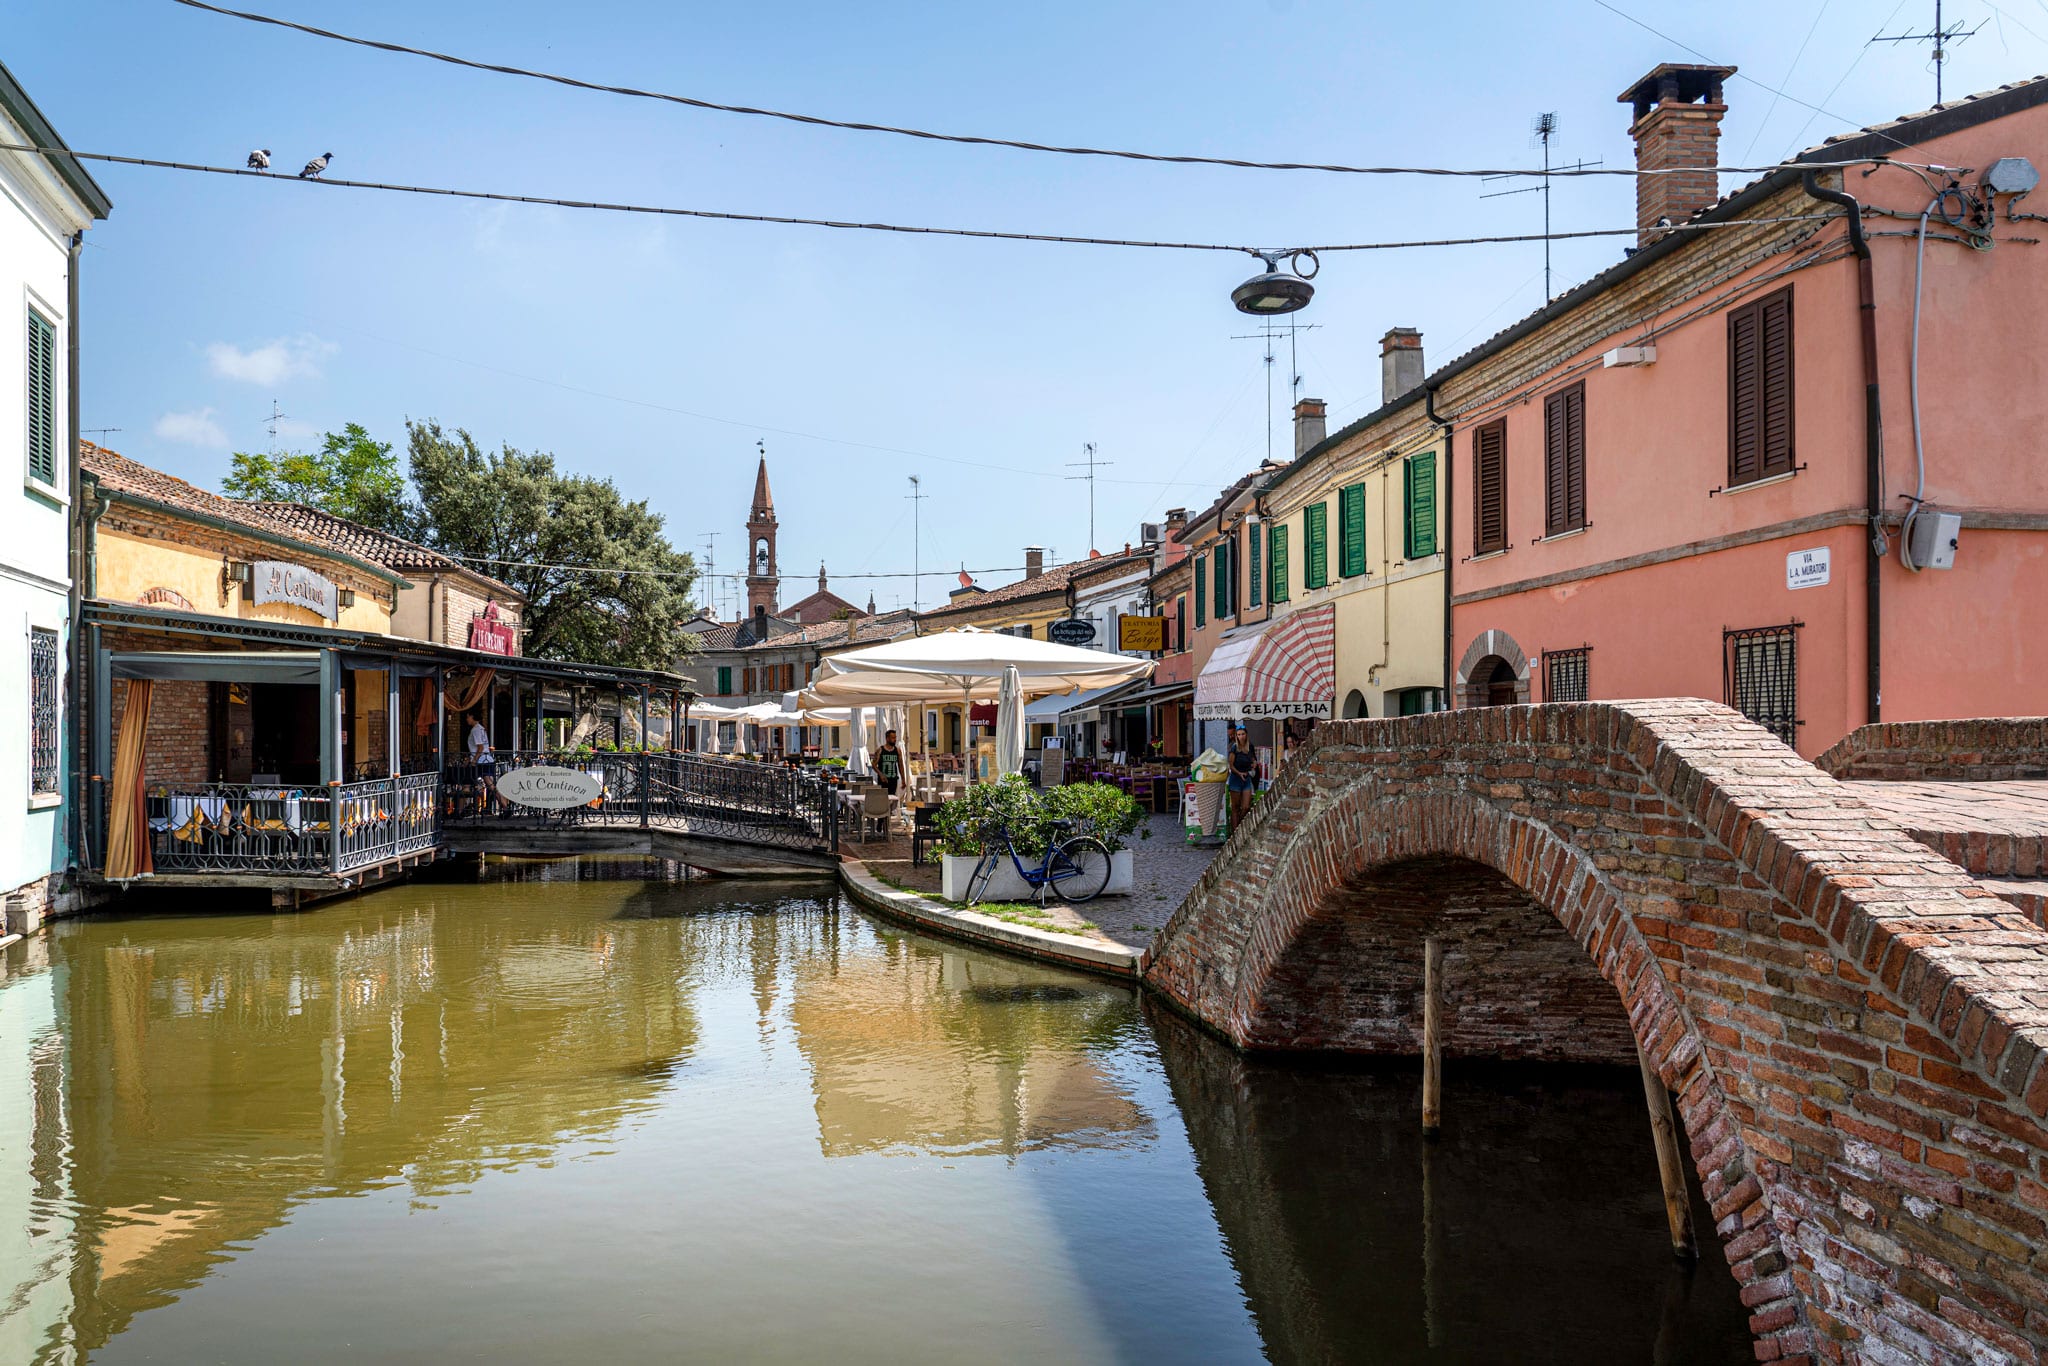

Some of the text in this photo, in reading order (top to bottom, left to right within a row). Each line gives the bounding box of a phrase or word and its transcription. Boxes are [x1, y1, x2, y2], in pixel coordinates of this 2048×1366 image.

[1803, 553, 1812, 563] VIA
[1801, 563, 1827, 576] MURATORI
[478, 629, 485, 648] LE
[1241, 703, 1328, 715] GELATERIA
[511, 777, 587, 795] Al Cantinon
